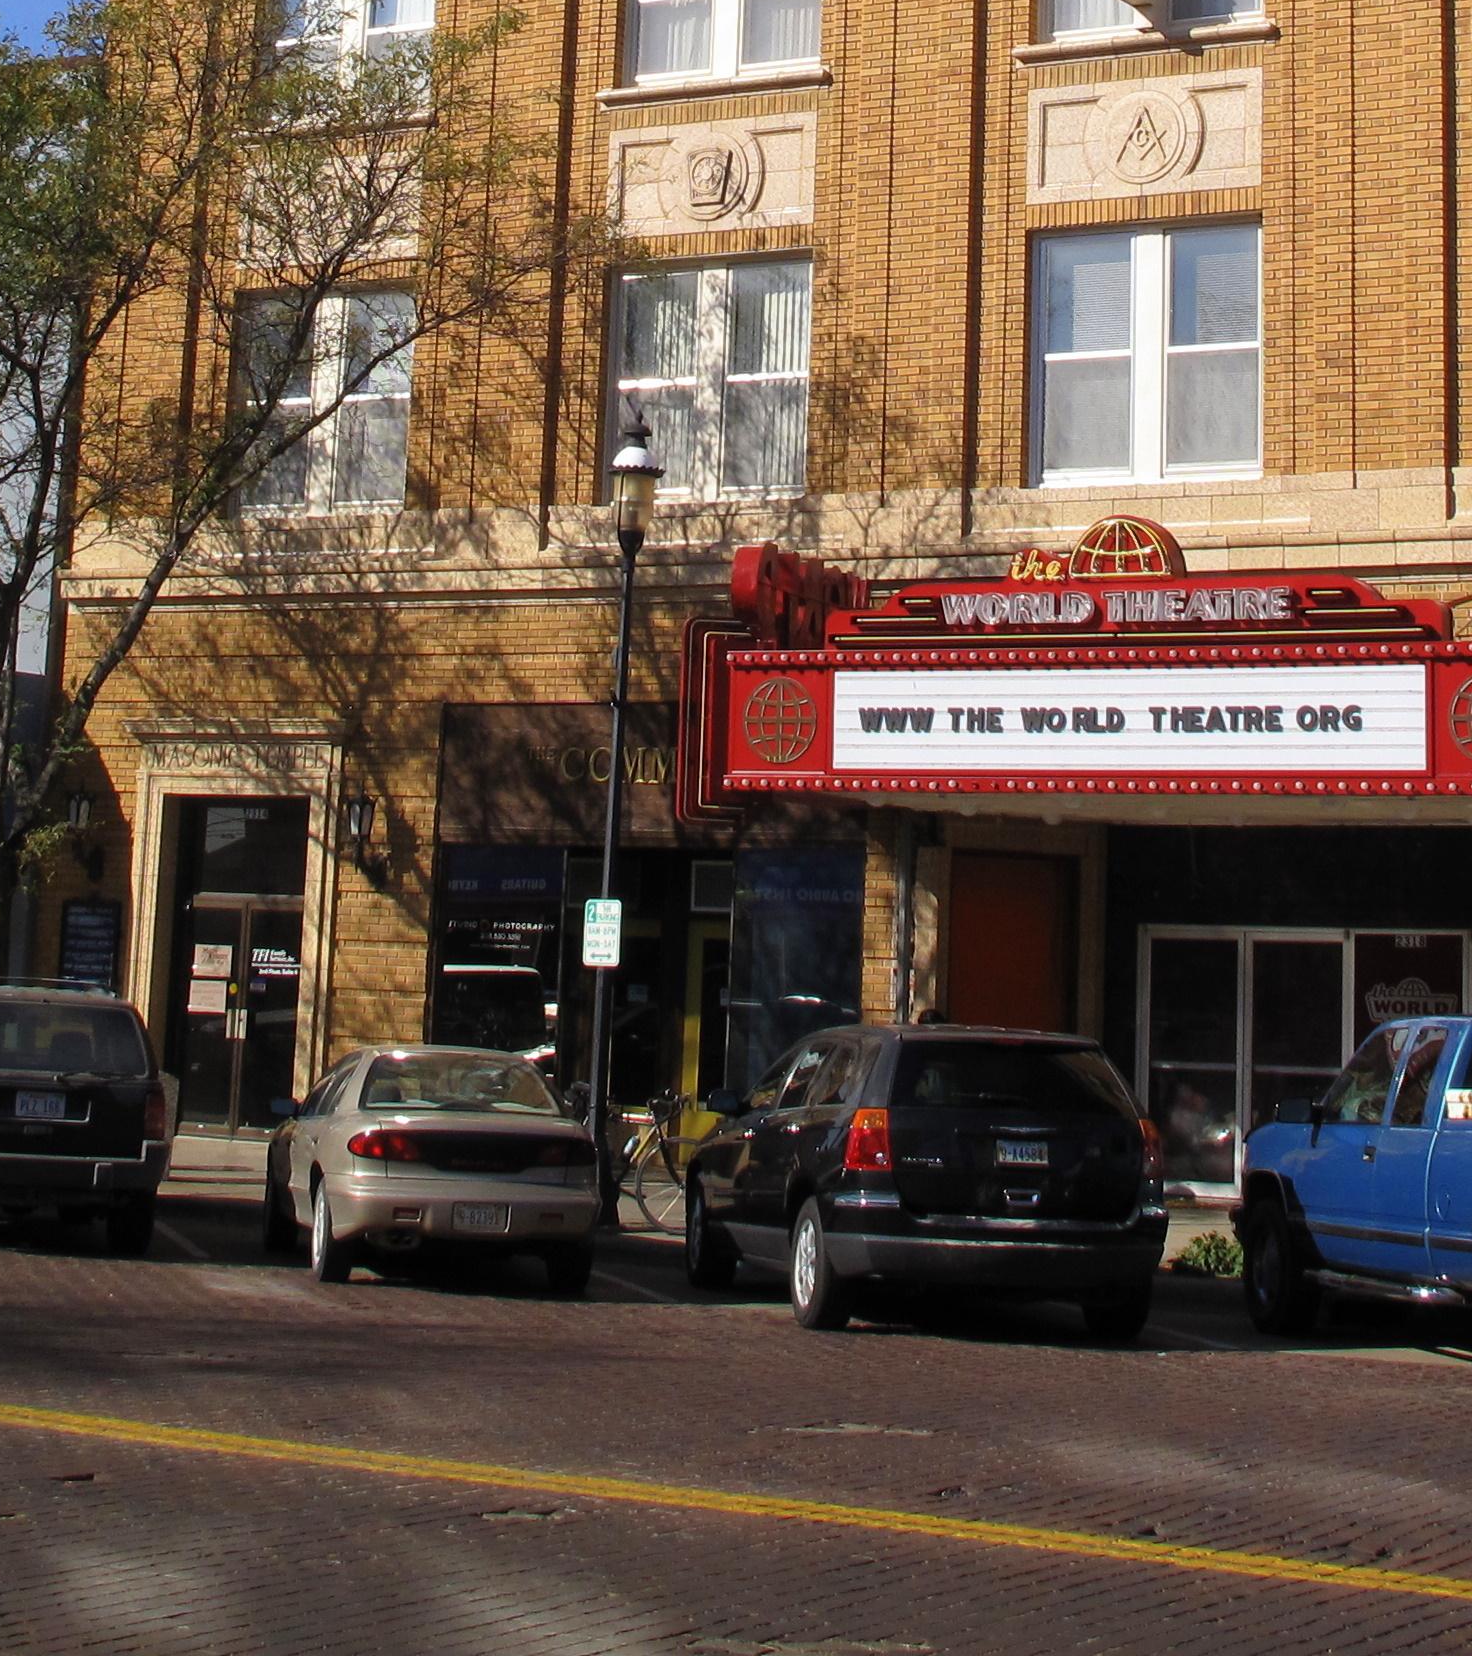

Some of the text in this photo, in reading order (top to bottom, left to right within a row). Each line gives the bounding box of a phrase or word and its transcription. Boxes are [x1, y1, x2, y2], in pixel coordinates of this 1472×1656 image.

[1011, 548, 1064, 582] the
[940, 586, 1297, 626] WORLD THEATRE
[858, 705, 1363, 733] WWW THE WORLD THEATRE ORG
[152, 744, 326, 770] MASONIC TEMPLE
[588, 904, 596, 922] 2
[252, 948, 270, 962] TFI
